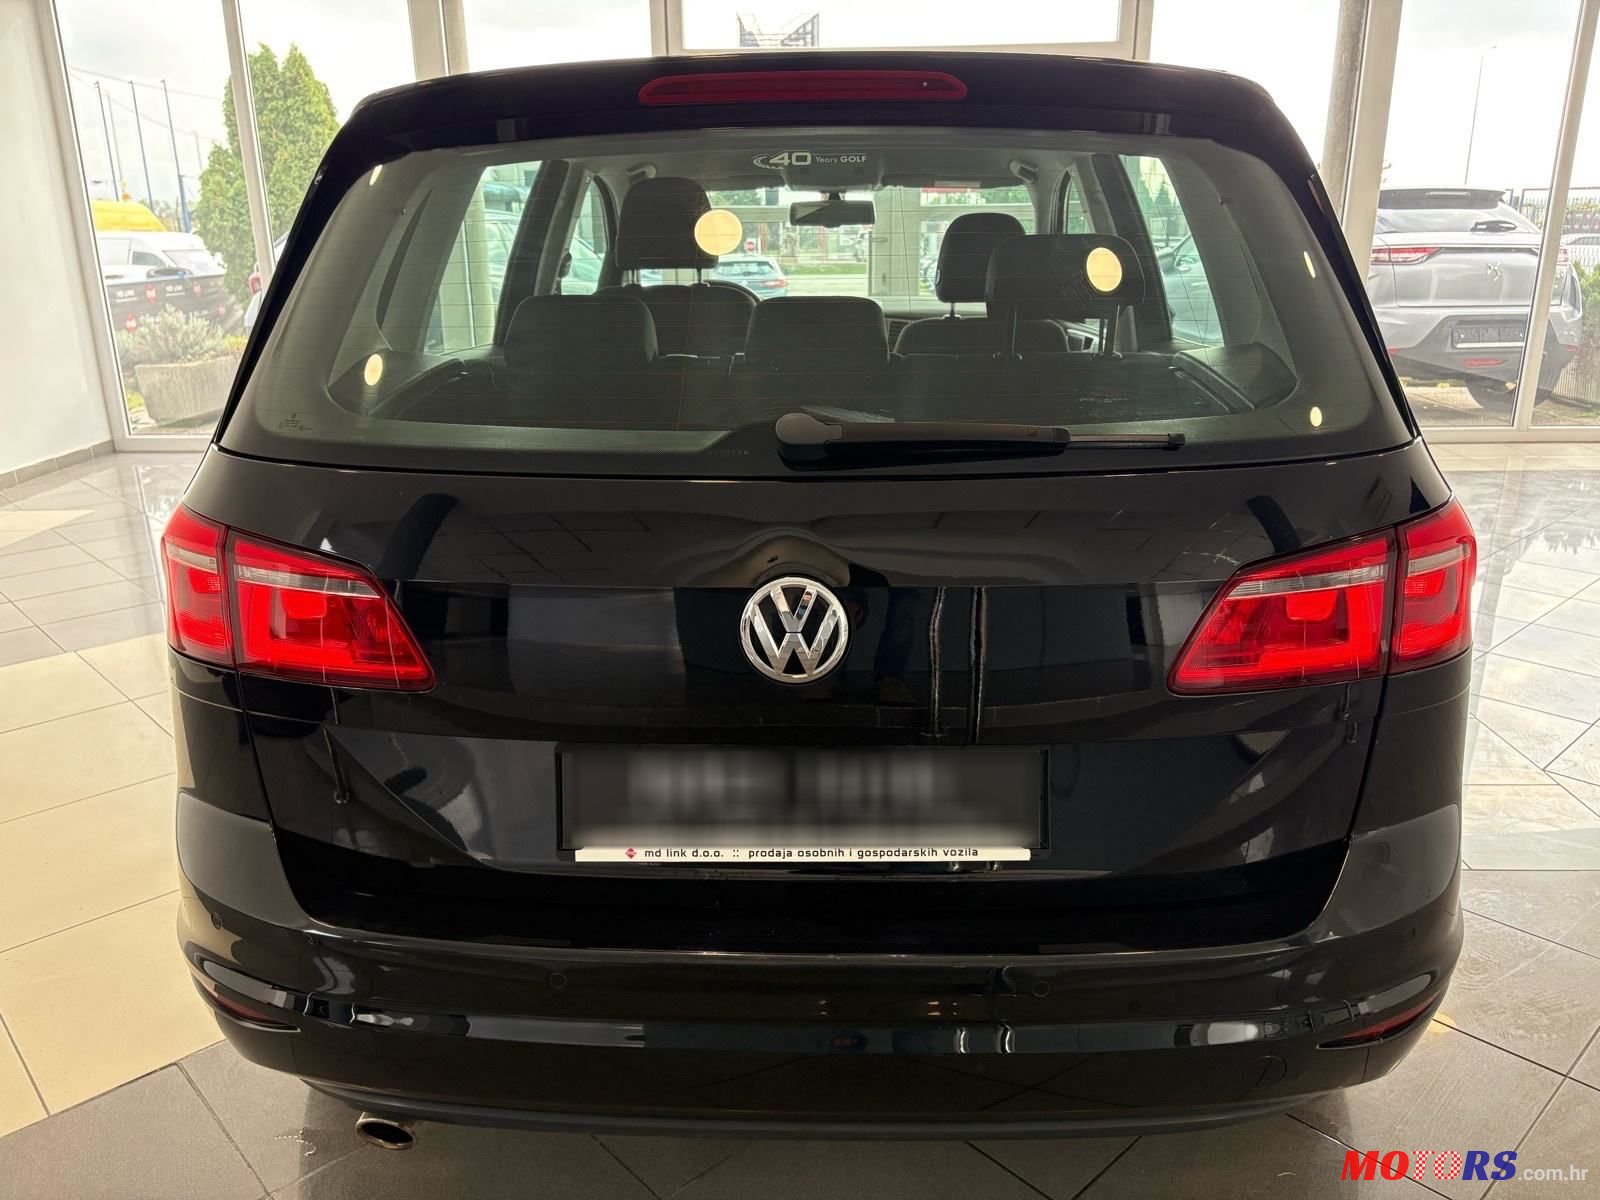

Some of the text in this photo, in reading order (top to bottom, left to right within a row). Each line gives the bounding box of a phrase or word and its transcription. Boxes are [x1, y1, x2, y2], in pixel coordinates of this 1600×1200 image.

[769, 152, 867, 166] 40 Years GOLF
[742, 578, 847, 682] VW
[644, 848, 661, 858] md
[666, 848, 687, 858] link
[692, 848, 724, 858] d.o.o.
[748, 848, 793, 860] prodaja
[797, 848, 845, 858] osobnih
[857, 848, 938, 860] gospodarskih
[943, 847, 979, 857] vozila
